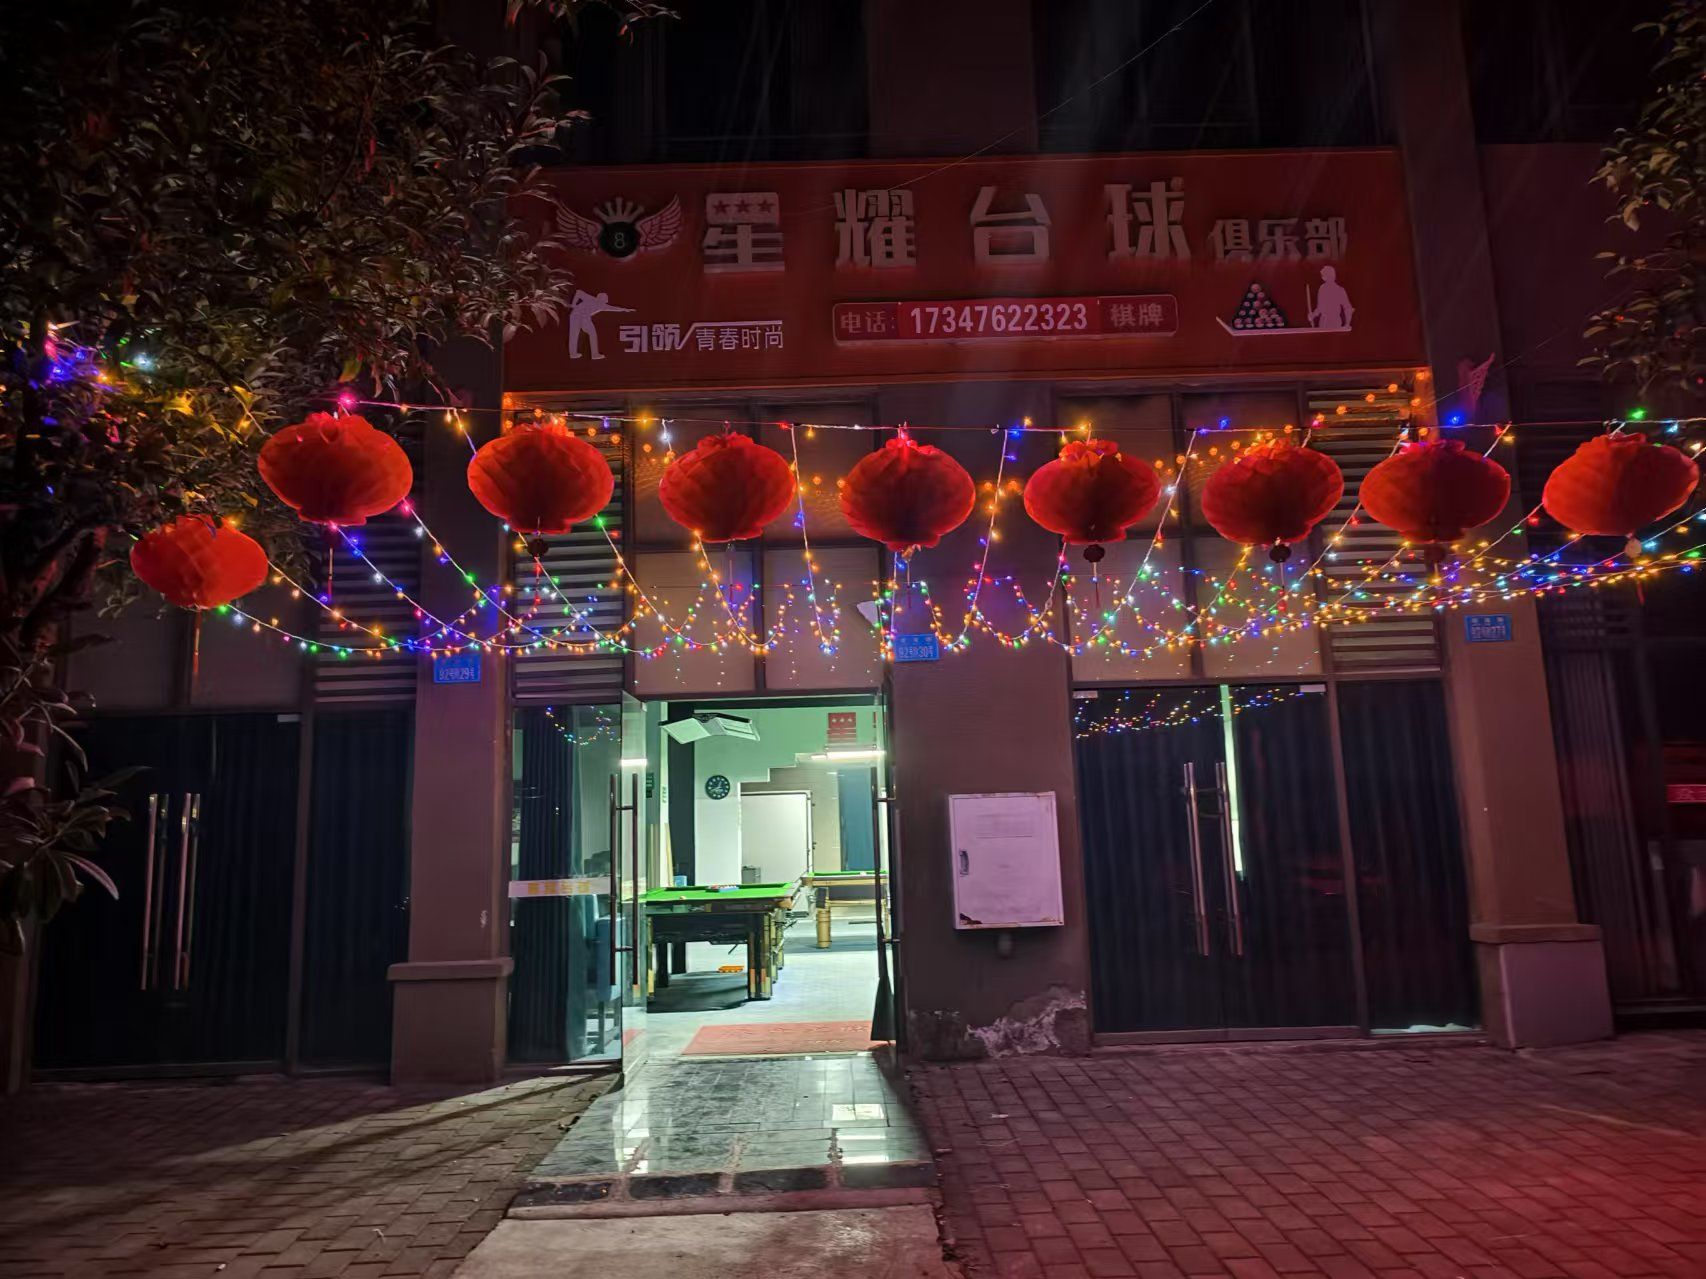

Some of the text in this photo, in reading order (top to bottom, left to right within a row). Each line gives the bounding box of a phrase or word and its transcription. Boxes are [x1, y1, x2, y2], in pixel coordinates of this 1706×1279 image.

[1208, 217, 1348, 263] 俱乐部
[910, 303, 1088, 336] 17347622323
[1109, 302, 1165, 328] 棋牌
[695, 325, 785, 352] 青春时尚
